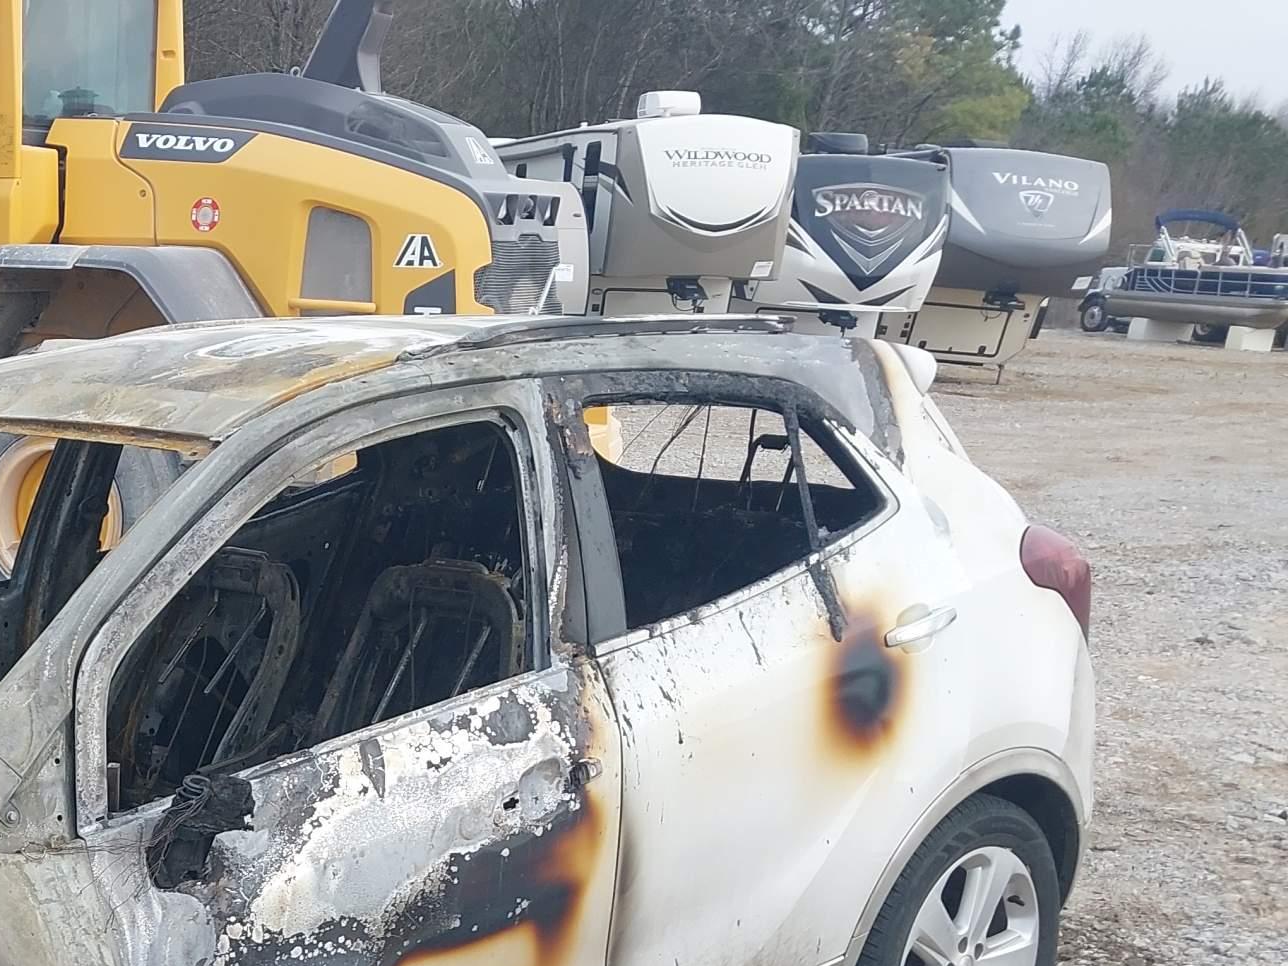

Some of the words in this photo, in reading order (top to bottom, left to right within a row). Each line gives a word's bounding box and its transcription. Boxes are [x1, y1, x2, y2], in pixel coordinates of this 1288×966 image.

[135, 133, 235, 153] VOLVO
[664, 149, 772, 163] WILDWOOD
[672, 160, 734, 168] HERITAGE
[992, 172, 1079, 191] VILANO
[814, 190, 923, 221] SPARTAN
